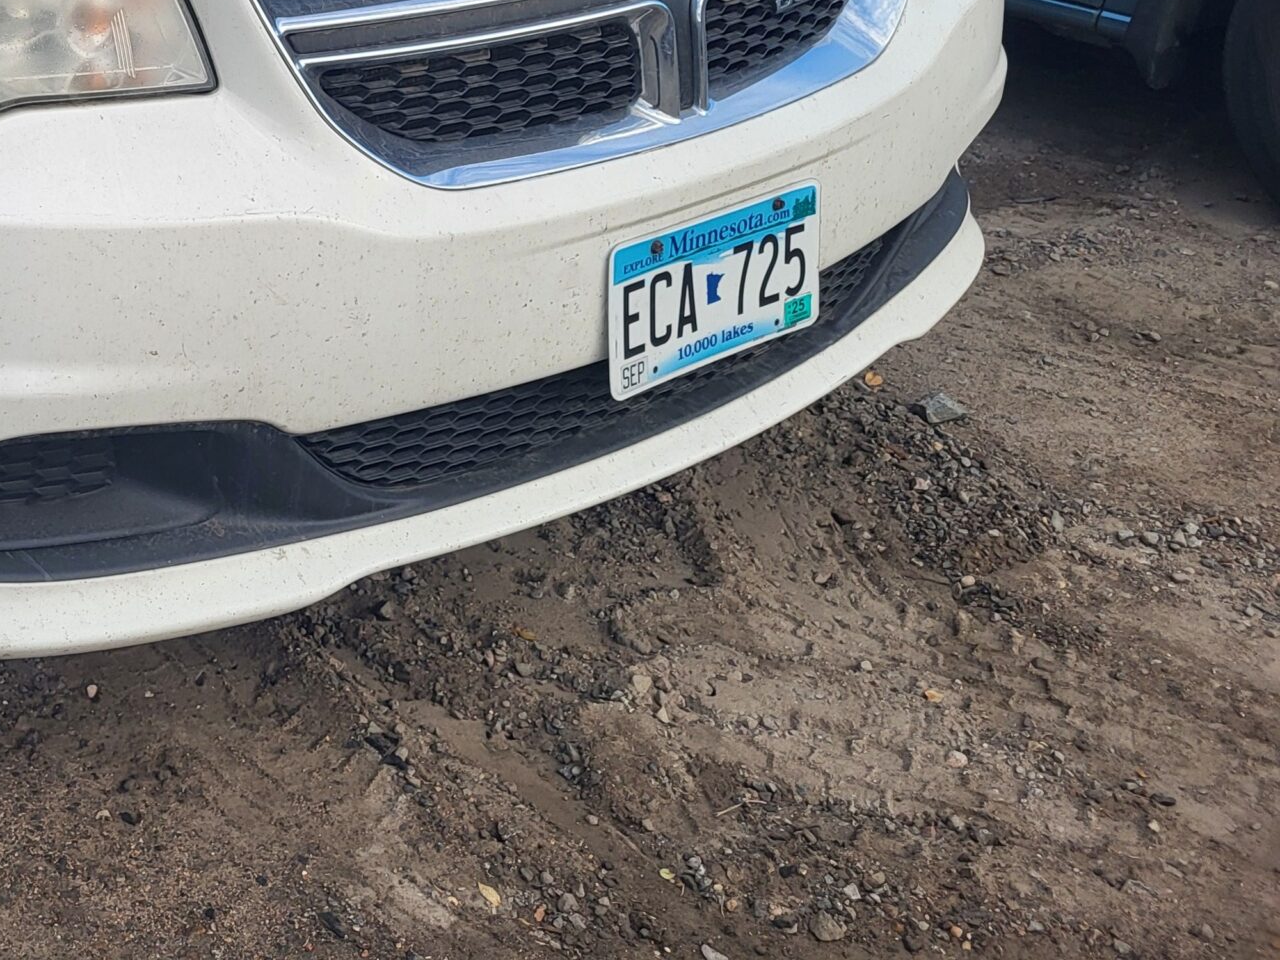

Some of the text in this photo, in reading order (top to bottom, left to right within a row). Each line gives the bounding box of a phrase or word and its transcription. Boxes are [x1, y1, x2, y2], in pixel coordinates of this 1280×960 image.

[623, 208, 790, 275] EXPLORE Minnesota.com
[623, 223, 806, 360] ECA 725
[792, 298, 805, 315] 25
[677, 322, 754, 361] 10,000 lakes
[622, 361, 645, 390] SEP
